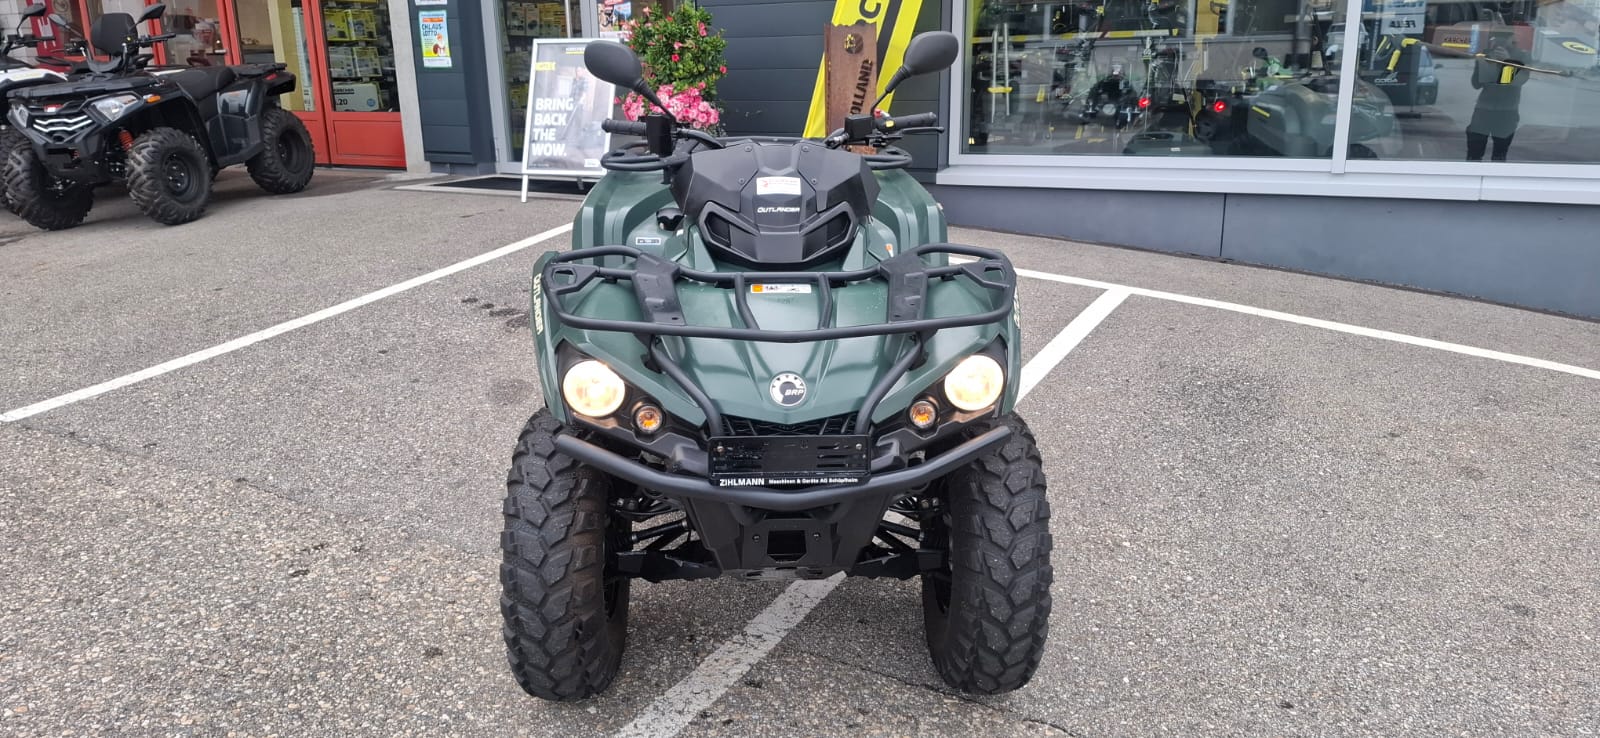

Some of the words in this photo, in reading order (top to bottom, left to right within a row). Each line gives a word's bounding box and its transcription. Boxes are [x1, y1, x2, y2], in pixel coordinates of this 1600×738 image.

[850, 58, 873, 116] OLLAND
[535, 98, 574, 111] BRING
[534, 113, 567, 126] BACK
[532, 127, 557, 141] THE
[531, 143, 567, 157] WOW.
[757, 206, 801, 214] OUTLANDER
[533, 272, 544, 335] OUTLANDER
[719, 478, 765, 487] ZIHLMANN
